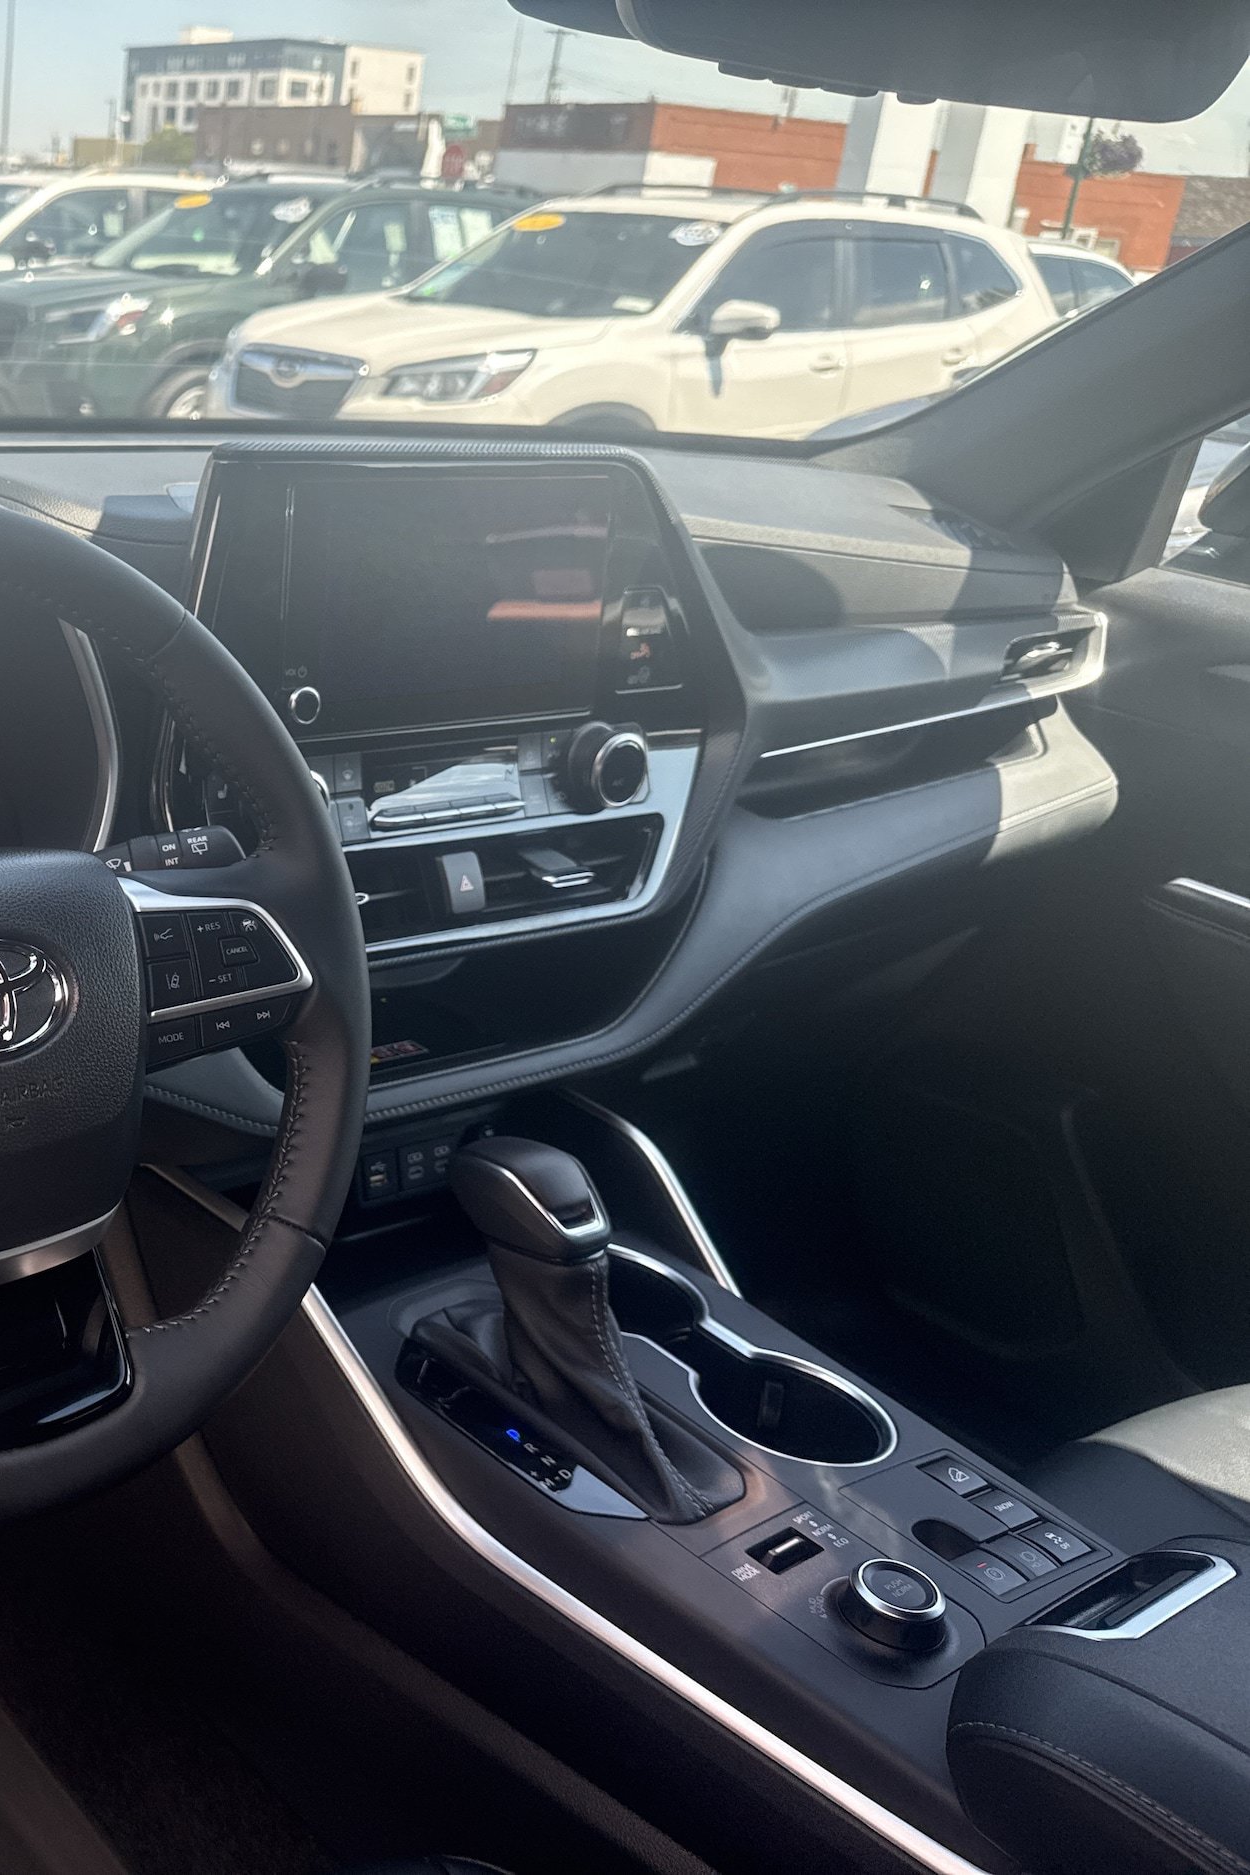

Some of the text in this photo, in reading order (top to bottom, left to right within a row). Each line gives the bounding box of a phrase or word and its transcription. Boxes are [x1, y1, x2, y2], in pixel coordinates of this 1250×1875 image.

[187, 835, 208, 845] REAR
[162, 843, 176, 853] ON
[164, 857, 179, 867] INT
[225, 945, 249, 956] CANCEL
[158, 1031, 185, 1044] MODE
[993, 1501, 1015, 1512] SNOW
[792, 1510, 815, 1524] SPORT
[811, 1523, 835, 1537] NORM
[833, 1537, 850, 1548] ECO
